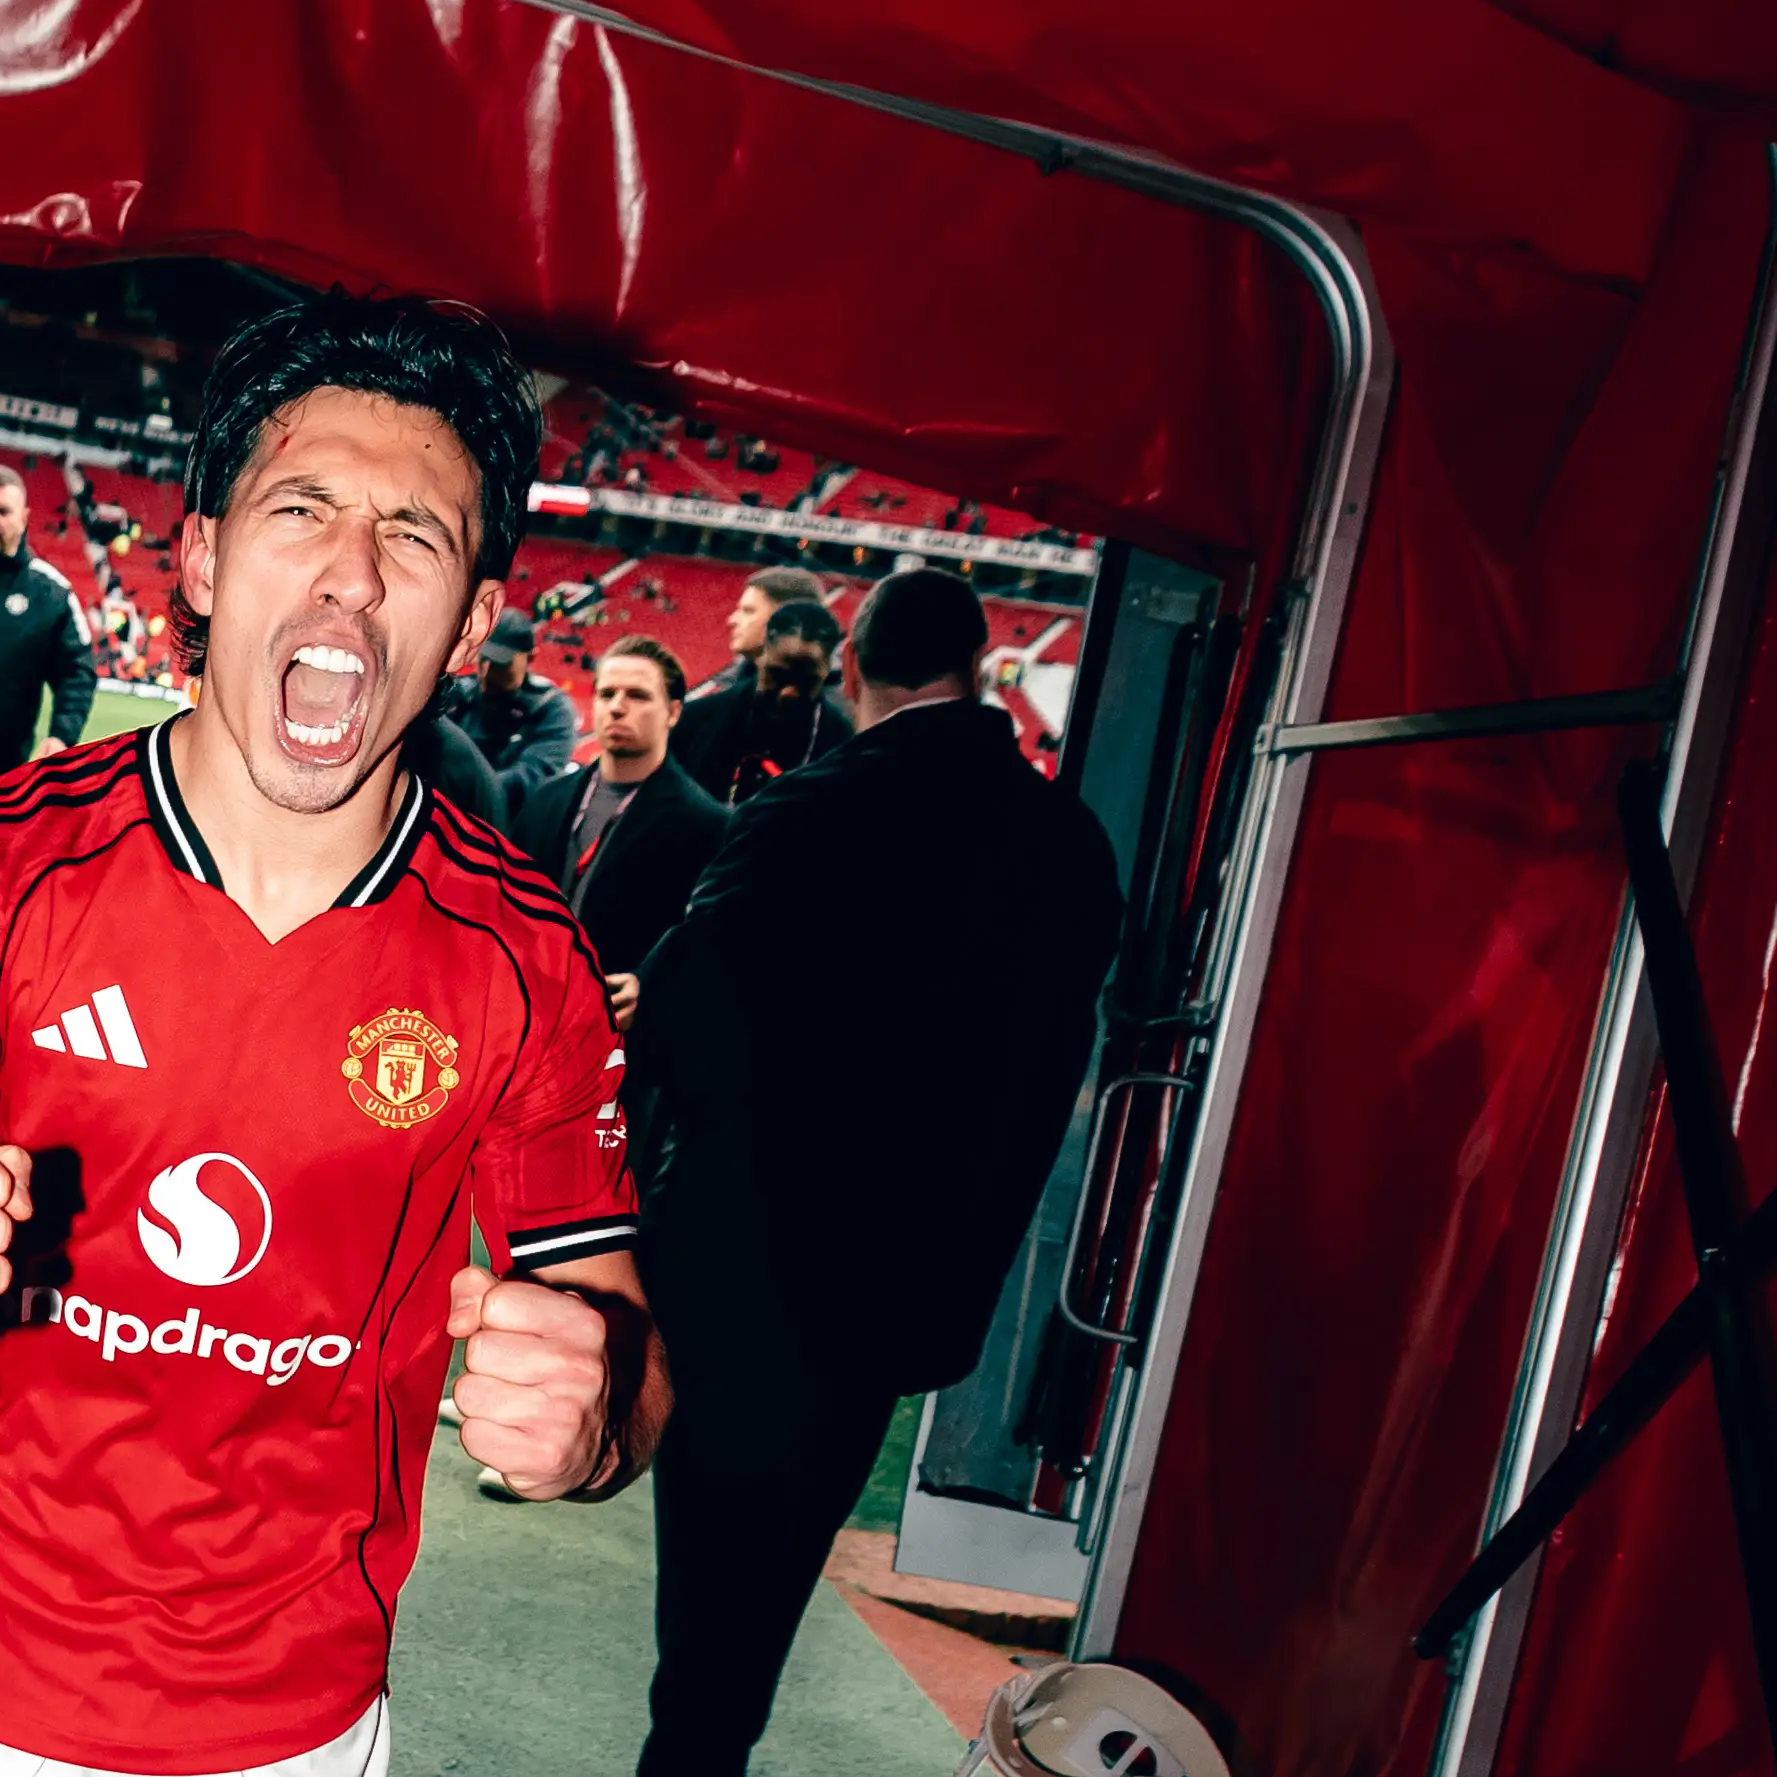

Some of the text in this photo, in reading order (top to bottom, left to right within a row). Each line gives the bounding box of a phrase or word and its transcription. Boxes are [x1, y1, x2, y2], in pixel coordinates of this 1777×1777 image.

[355, 1017, 450, 1060] MANCHESTER
[365, 1097, 430, 1120] UNITED
[21, 1286, 362, 1387] napdrago
